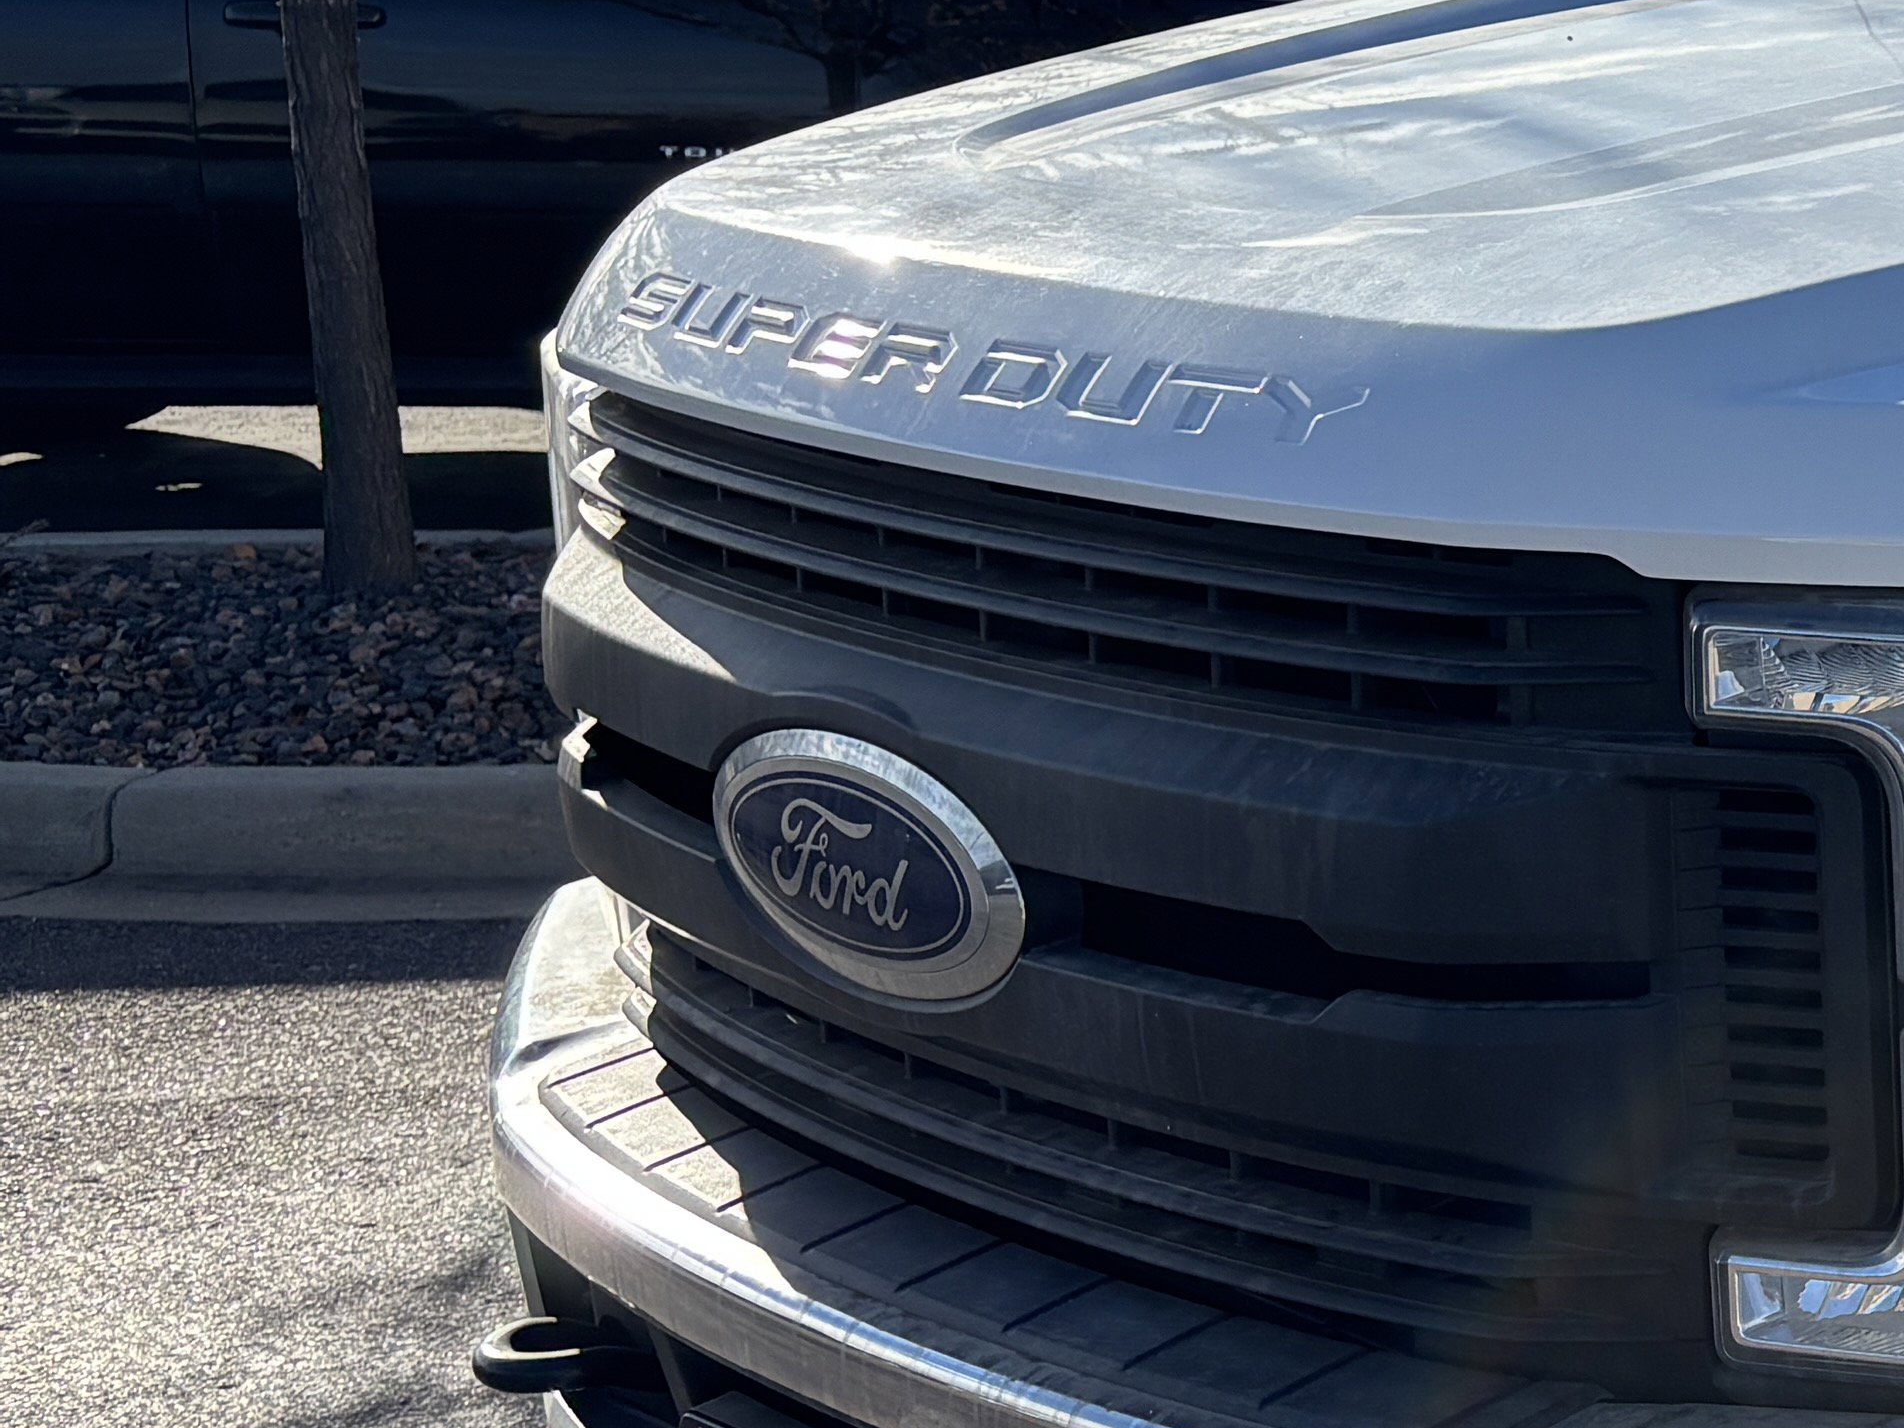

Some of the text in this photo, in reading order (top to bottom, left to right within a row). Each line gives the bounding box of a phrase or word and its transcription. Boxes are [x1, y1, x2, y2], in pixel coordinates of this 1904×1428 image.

[616, 269, 1372, 444] SUPER DUTY
[771, 798, 909, 932] Ford
